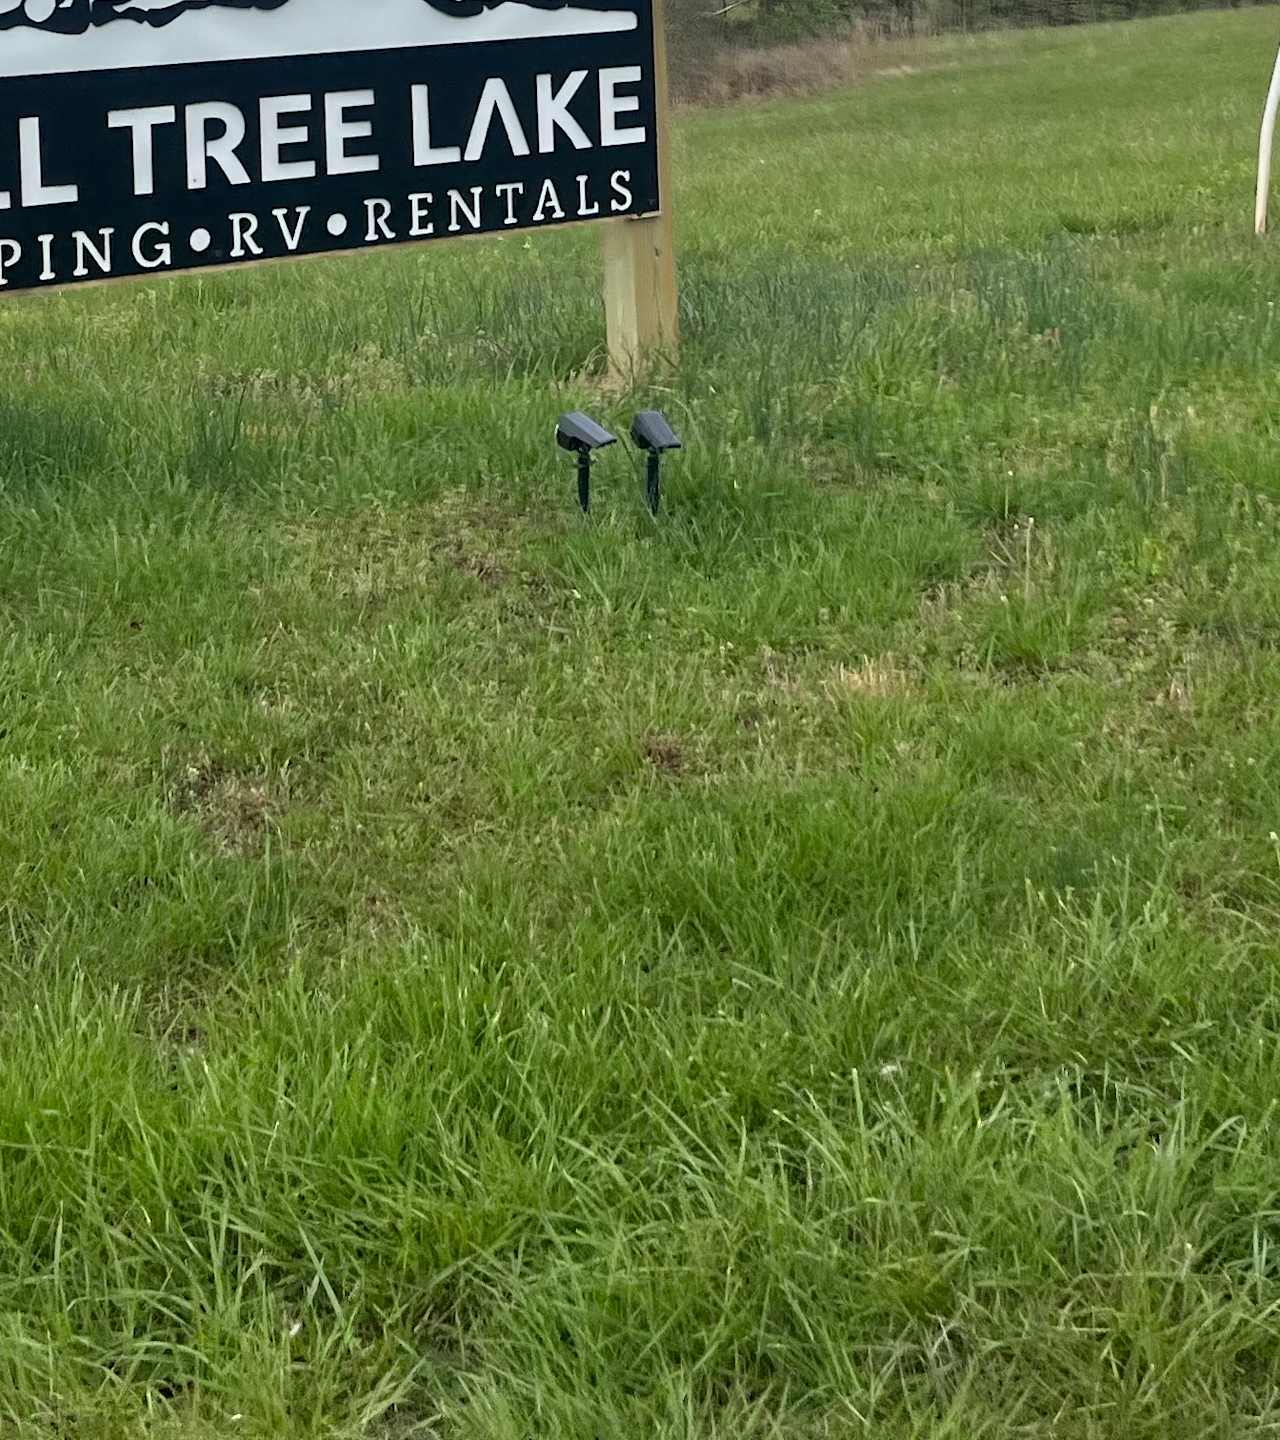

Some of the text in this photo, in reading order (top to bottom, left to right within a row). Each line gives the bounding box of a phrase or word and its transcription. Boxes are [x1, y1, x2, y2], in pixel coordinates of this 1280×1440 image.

[107, 89, 380, 196] TREE
[411, 65, 647, 167] LAKE
[228, 205, 312, 258] RV
[363, 169, 633, 242] RENTALS
